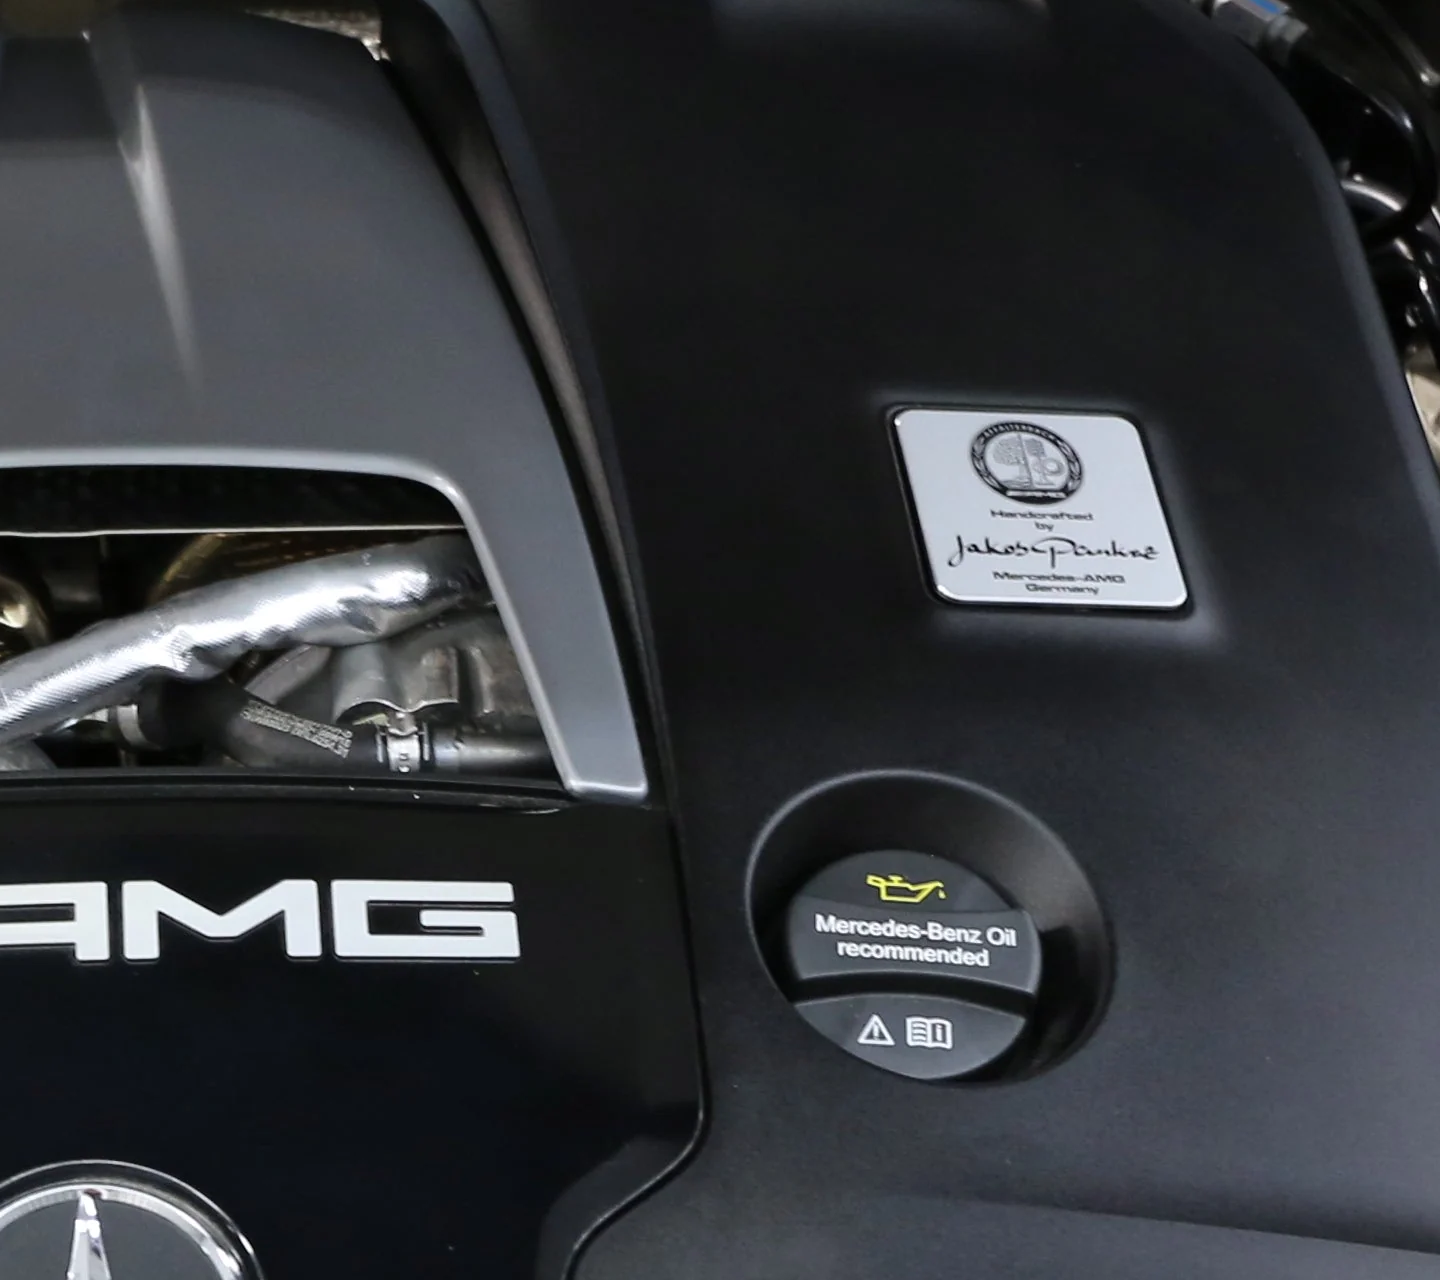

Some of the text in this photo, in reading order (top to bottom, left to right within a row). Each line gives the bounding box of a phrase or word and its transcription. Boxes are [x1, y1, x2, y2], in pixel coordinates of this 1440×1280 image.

[990, 509, 1094, 521] Handcrafted
[1034, 521, 1055, 532] by
[992, 570, 1126, 584] Mercedes-AMG
[1025, 583, 1100, 595] Germany
[814, 913, 1017, 947] Mercedes-Benz Oil
[837, 940, 990, 968] recommended
